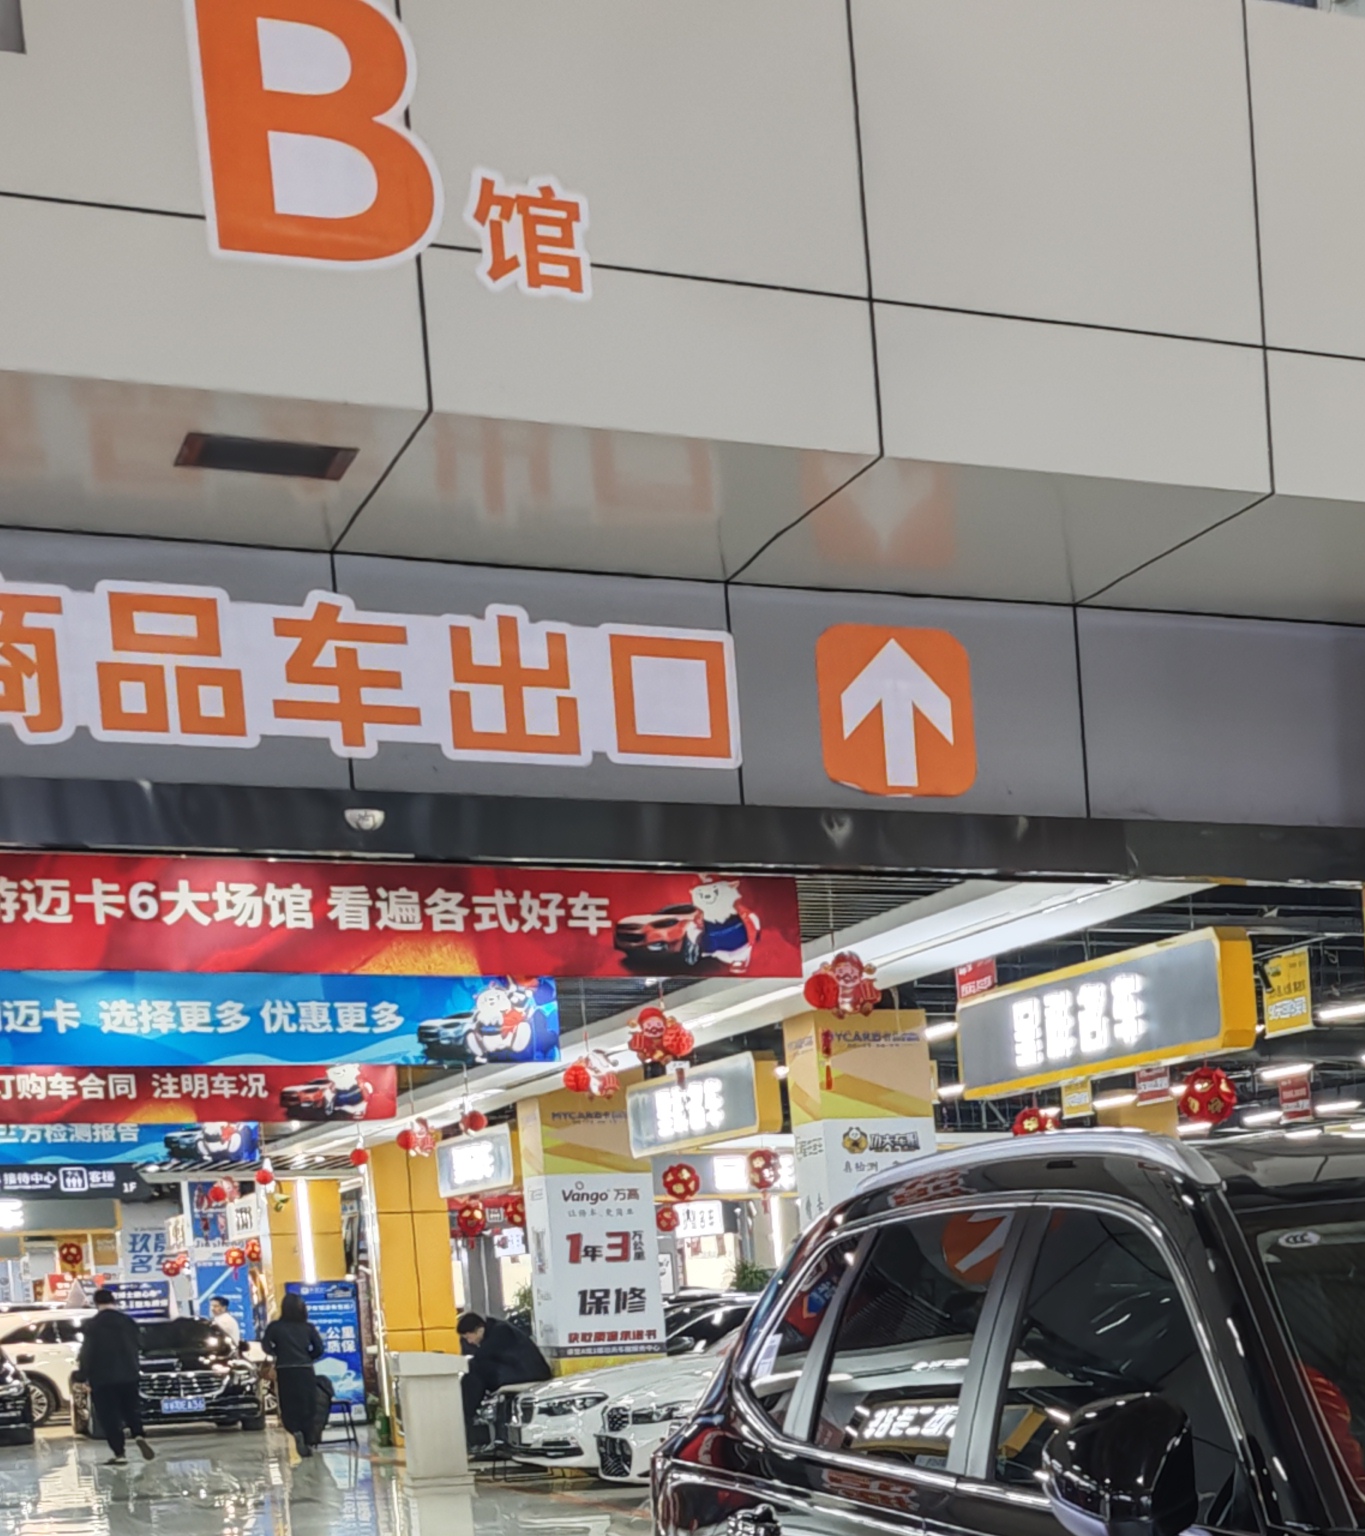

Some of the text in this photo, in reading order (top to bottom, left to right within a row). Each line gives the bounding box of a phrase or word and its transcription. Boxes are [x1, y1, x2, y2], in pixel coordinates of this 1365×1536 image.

[195, 0, 588, 295] B 馆
[327, 885, 613, 935] 看遍各式好车
[0, 999, 405, 1035] 迈卡 选择更多 优惠更多
[151, 1073, 269, 1100] 注明车况
[562, 1187, 609, 1205] Vango
[578, 1287, 647, 1315] 保修
